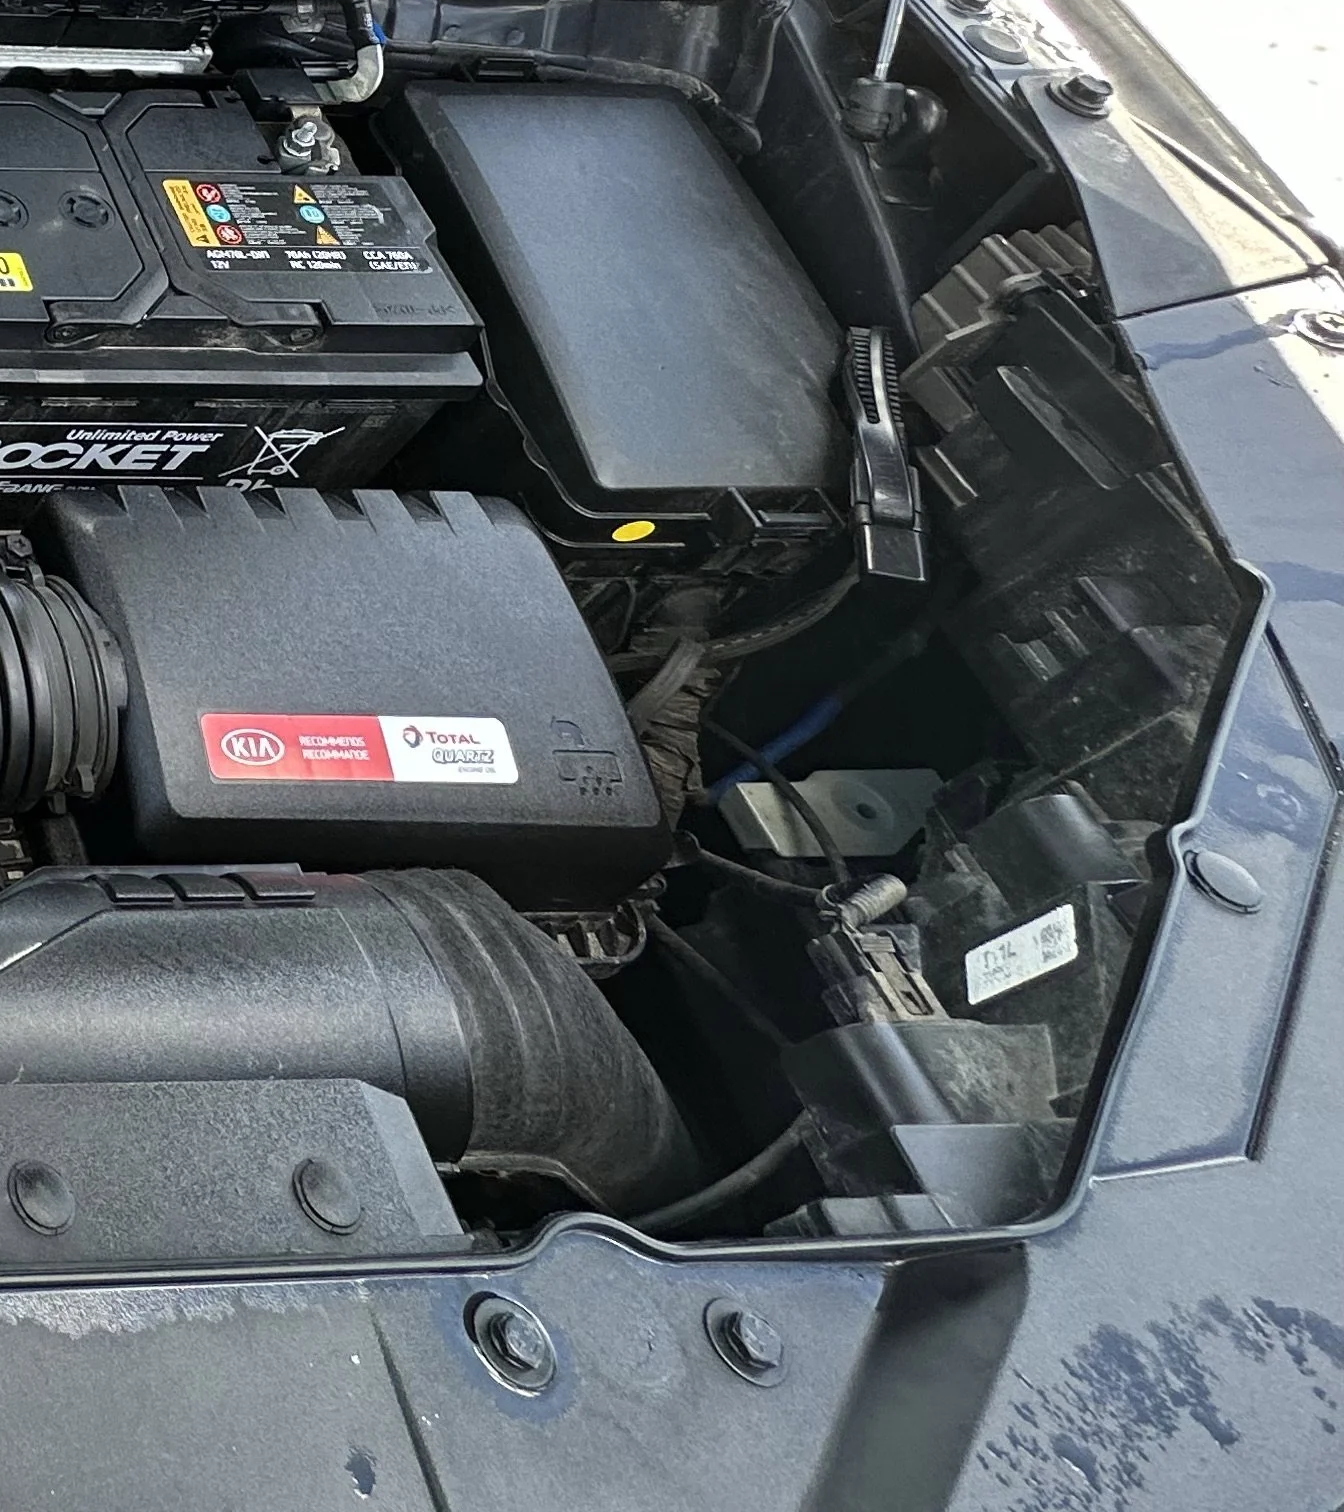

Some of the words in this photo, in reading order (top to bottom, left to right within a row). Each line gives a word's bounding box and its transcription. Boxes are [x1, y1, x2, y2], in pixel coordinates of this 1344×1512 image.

[66, 429, 157, 442] Unlimited
[161, 429, 224, 442] Power
[298, 735, 366, 748] RECOMMENDS
[426, 730, 482, 746] TOTAL
[230, 734, 277, 759] KIA
[431, 747, 495, 765] QUARTZ
